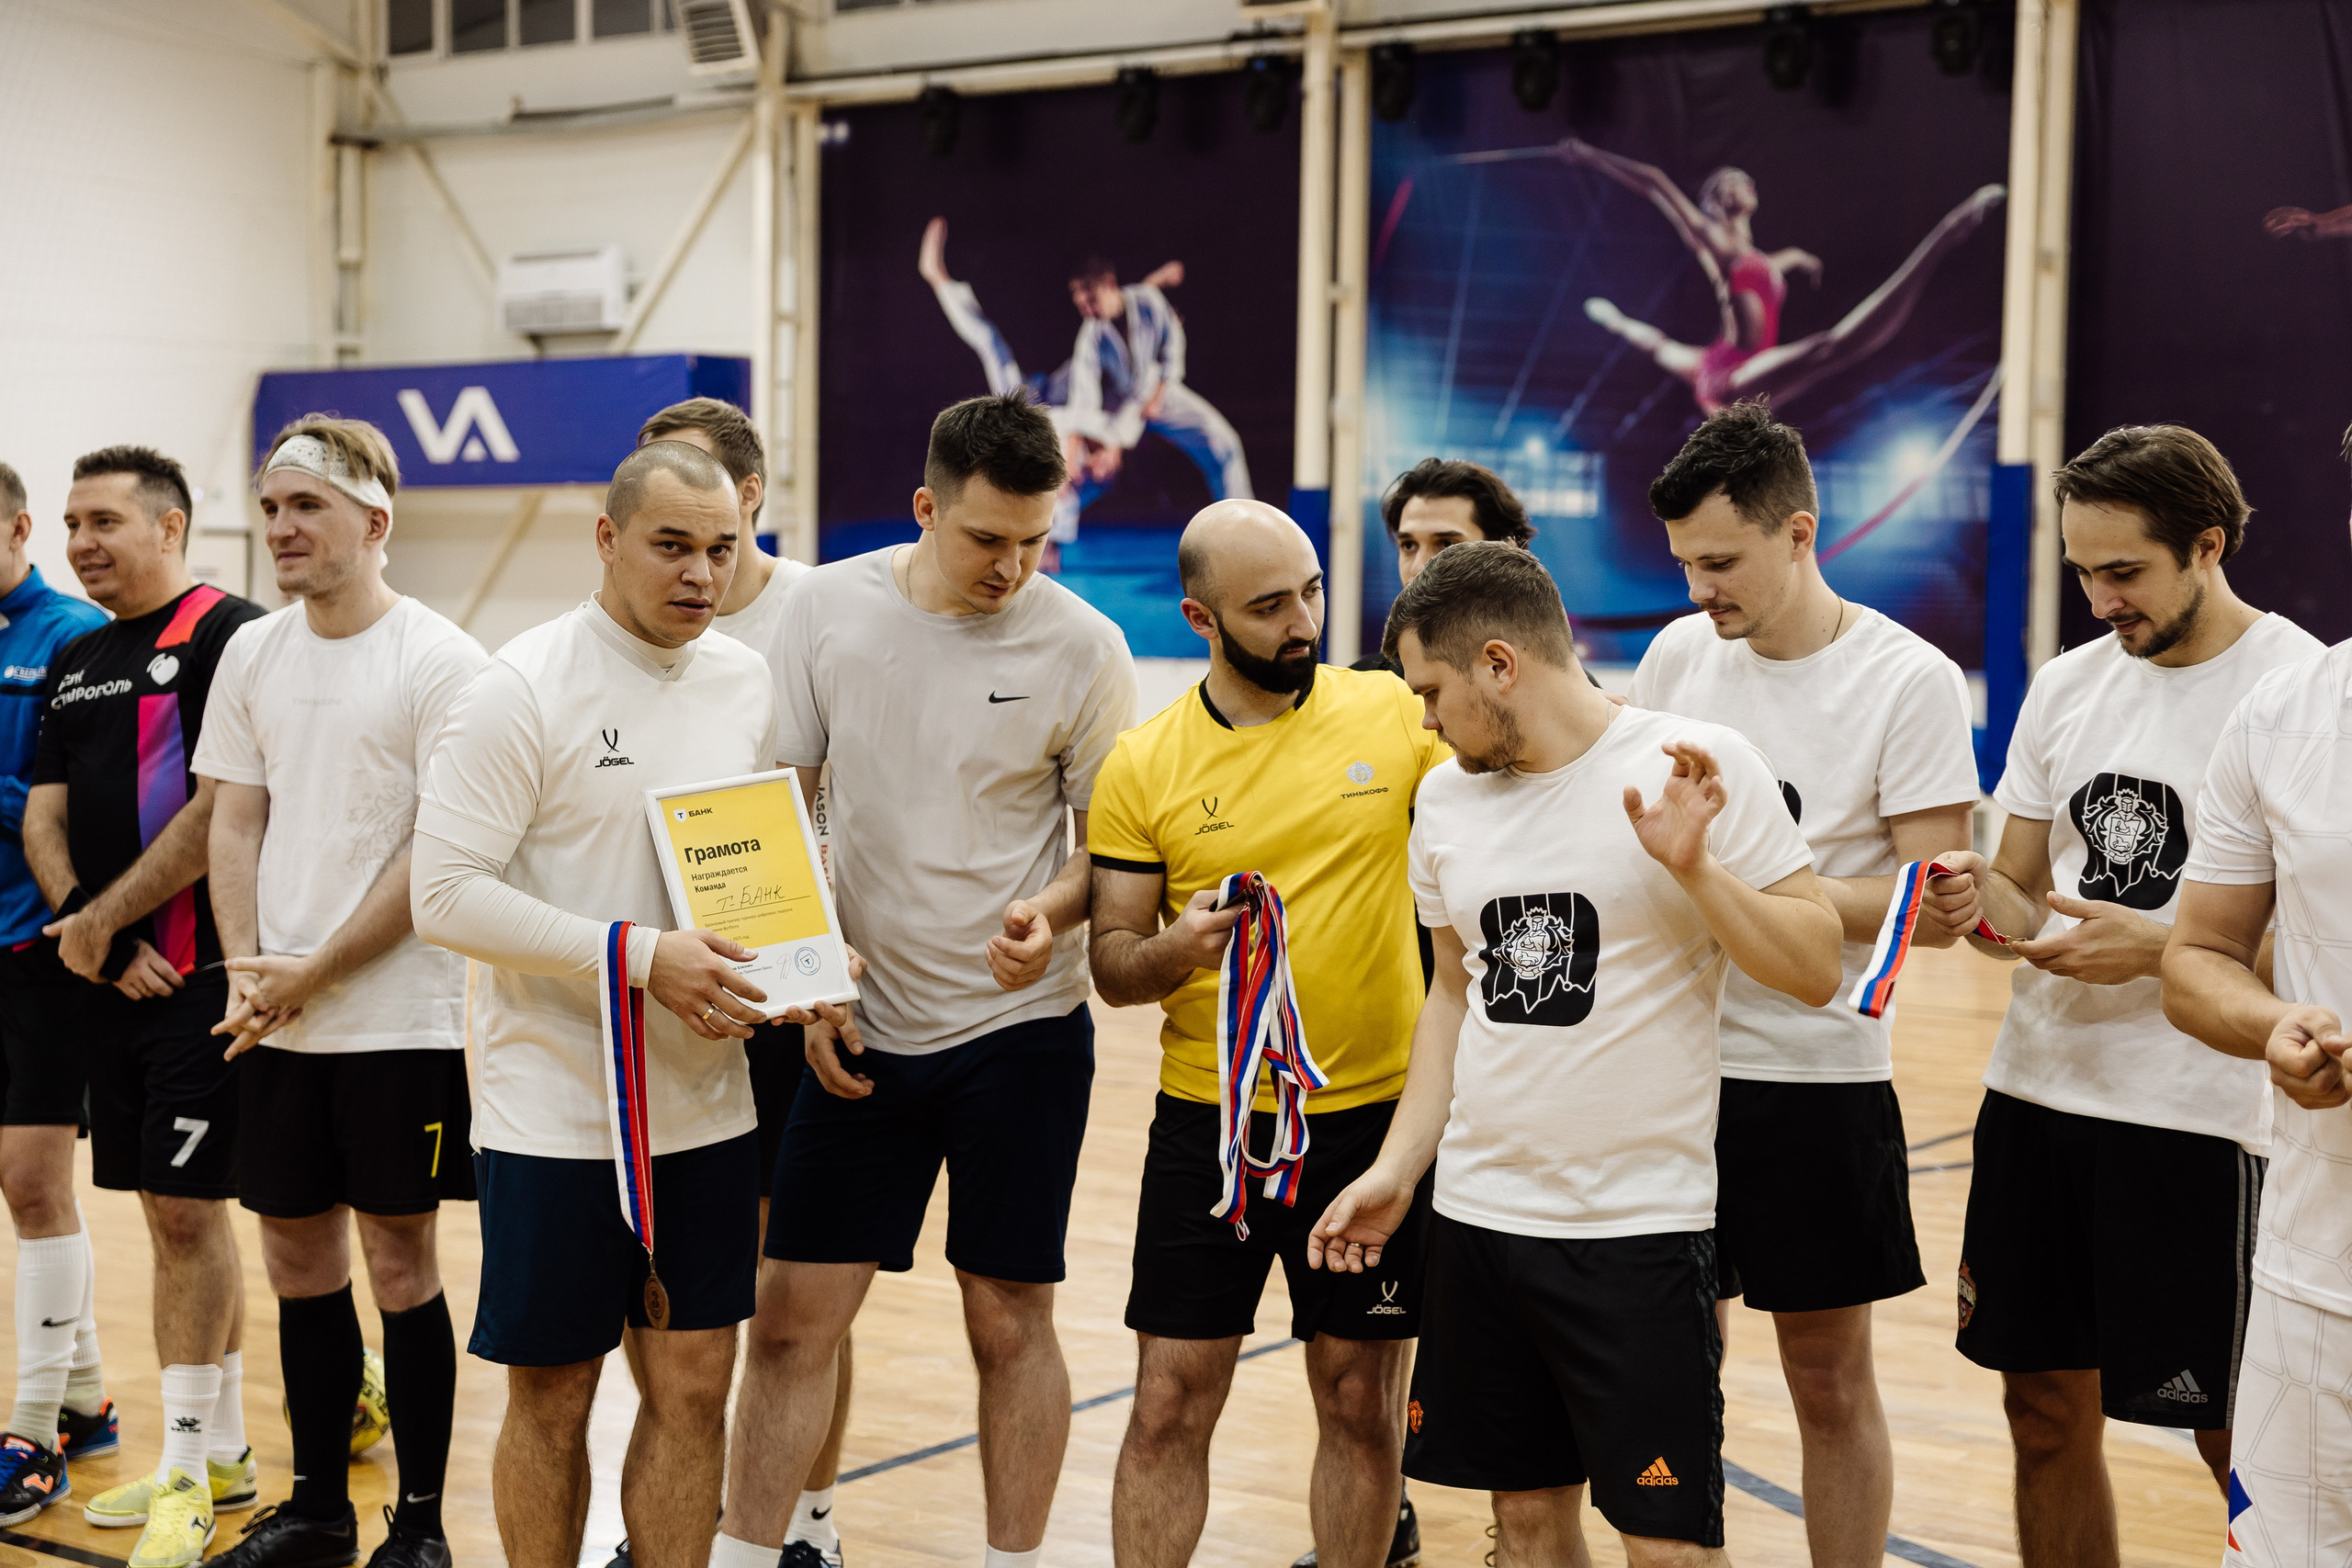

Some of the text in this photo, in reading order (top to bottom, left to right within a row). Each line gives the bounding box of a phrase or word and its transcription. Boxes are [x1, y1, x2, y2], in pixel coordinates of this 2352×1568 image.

[594, 756, 635, 768] JÖGEL
[1340, 786, 1389, 799] ТИНЬКОФФ
[688, 807, 713, 818] БАНК
[1194, 821, 1235, 835] JÖGEL
[684, 839, 762, 865] Грамота
[691, 865, 749, 882] Награждается
[694, 882, 727, 893] Команда
[170, 1116, 209, 1168] 7
[424, 1121, 443, 1179] 7
[1366, 1304, 1407, 1314] JÖGEL
[2156, 1388, 2209, 1404] adidas
[1636, 1475, 1679, 1486] adidas
